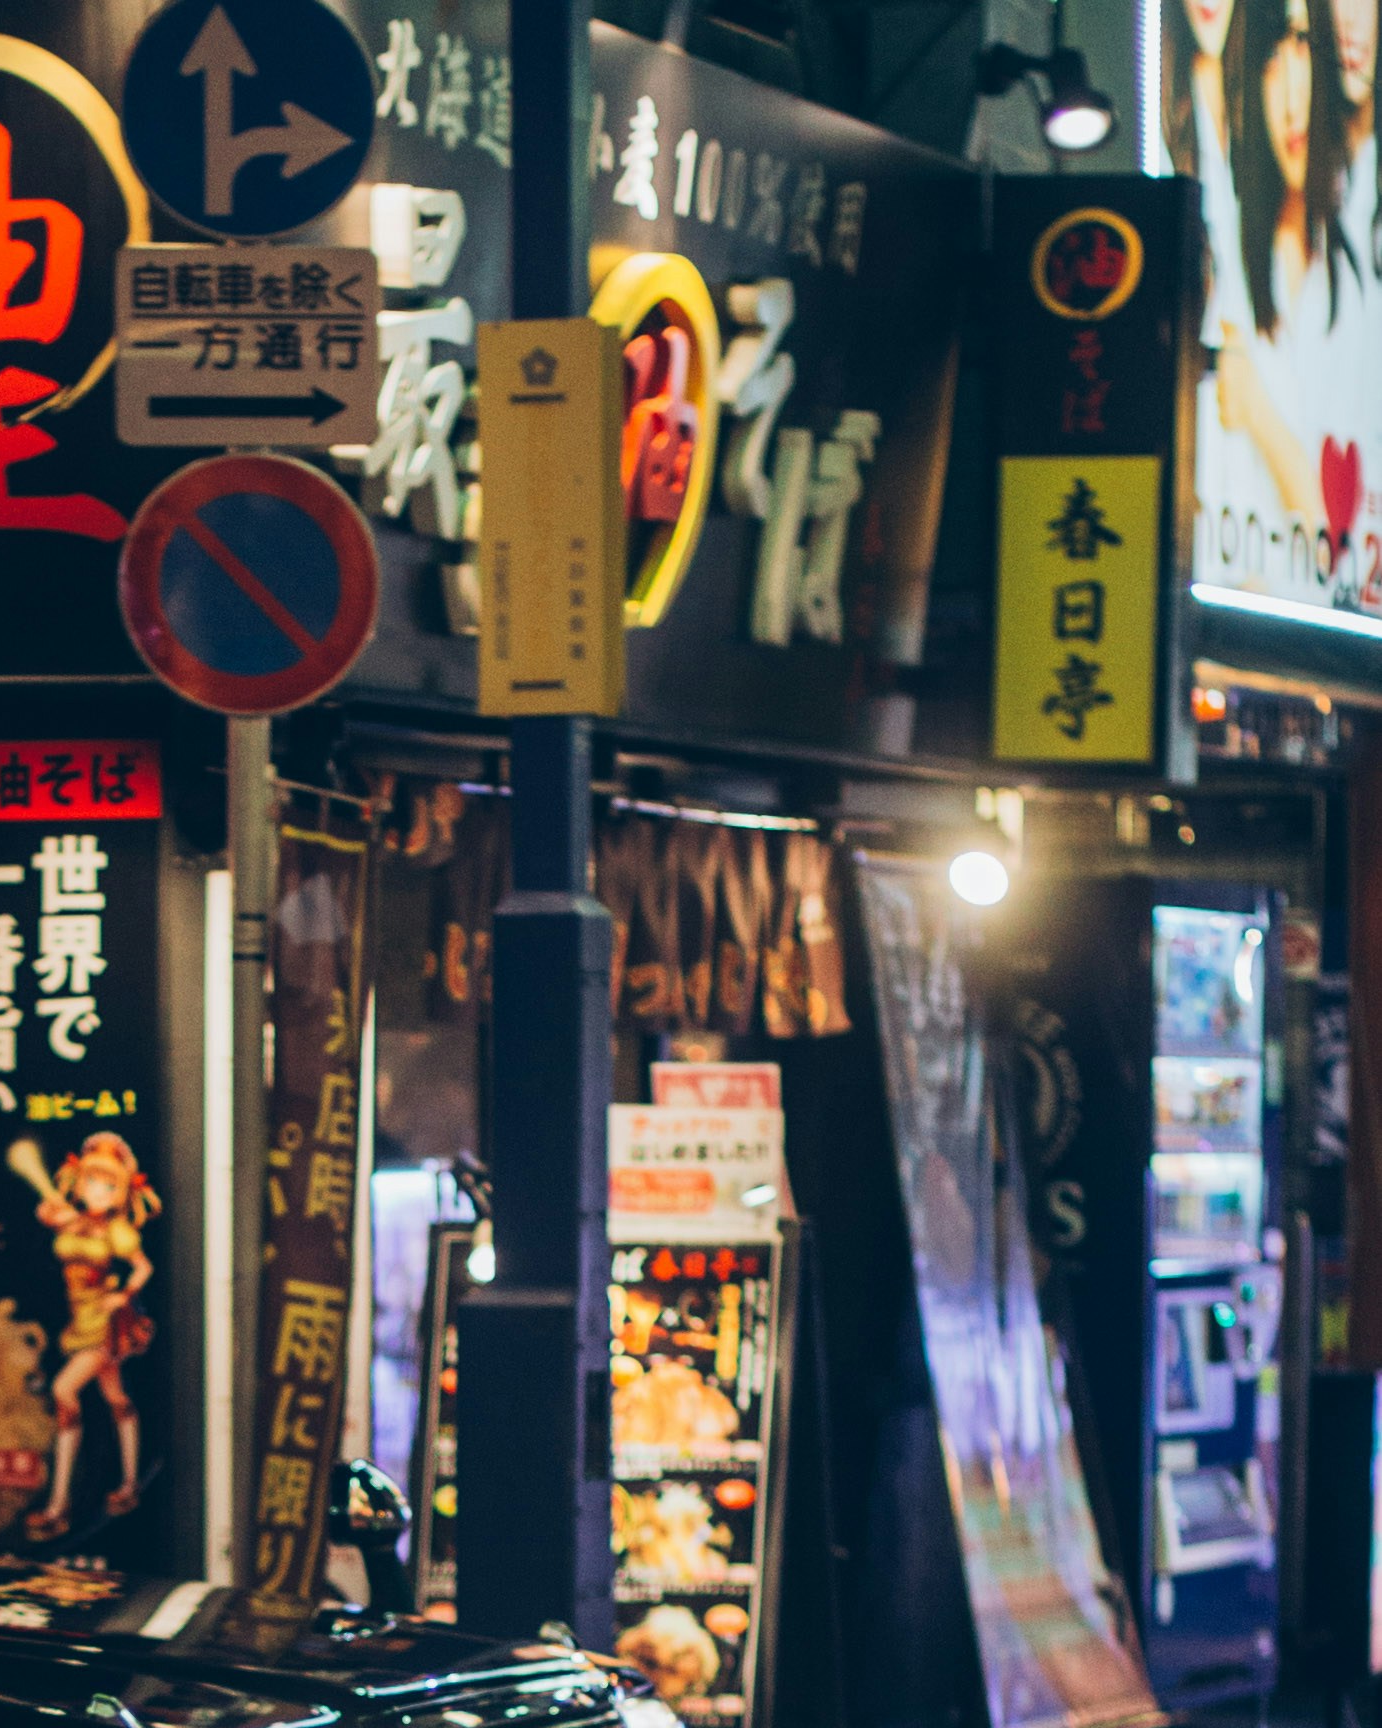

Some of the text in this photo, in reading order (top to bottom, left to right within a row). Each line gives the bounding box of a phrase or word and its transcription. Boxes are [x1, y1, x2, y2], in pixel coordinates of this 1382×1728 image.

[132, 323, 363, 371] 一方通行
[133, 263, 363, 308] 自転車を除く
[1042, 477, 1123, 742] 春日亭
[31, 834, 108, 1061] 世界で
